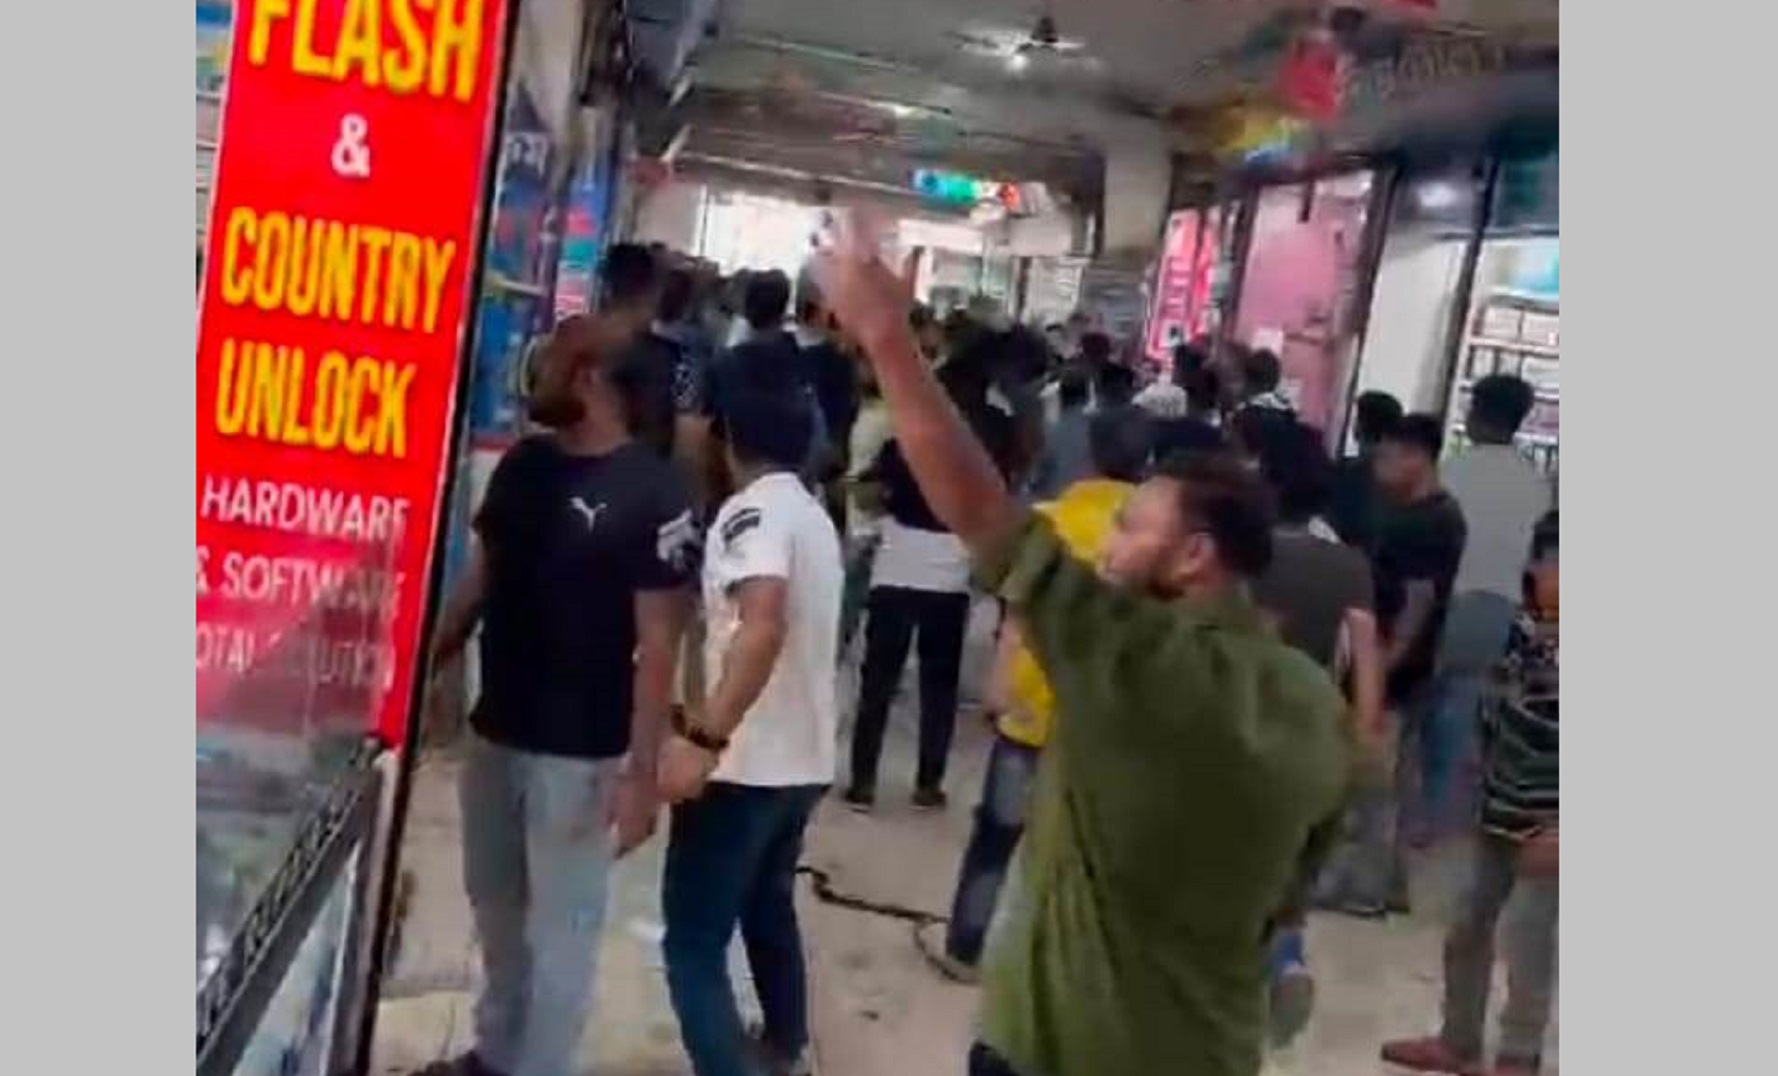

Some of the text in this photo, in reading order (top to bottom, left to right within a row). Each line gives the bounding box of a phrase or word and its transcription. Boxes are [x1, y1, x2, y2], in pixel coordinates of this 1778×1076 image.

[247, 0, 486, 103] FLASH
[331, 113, 371, 178] &
[220, 205, 457, 334] COUNTRY
[215, 337, 417, 459] UNLOCK
